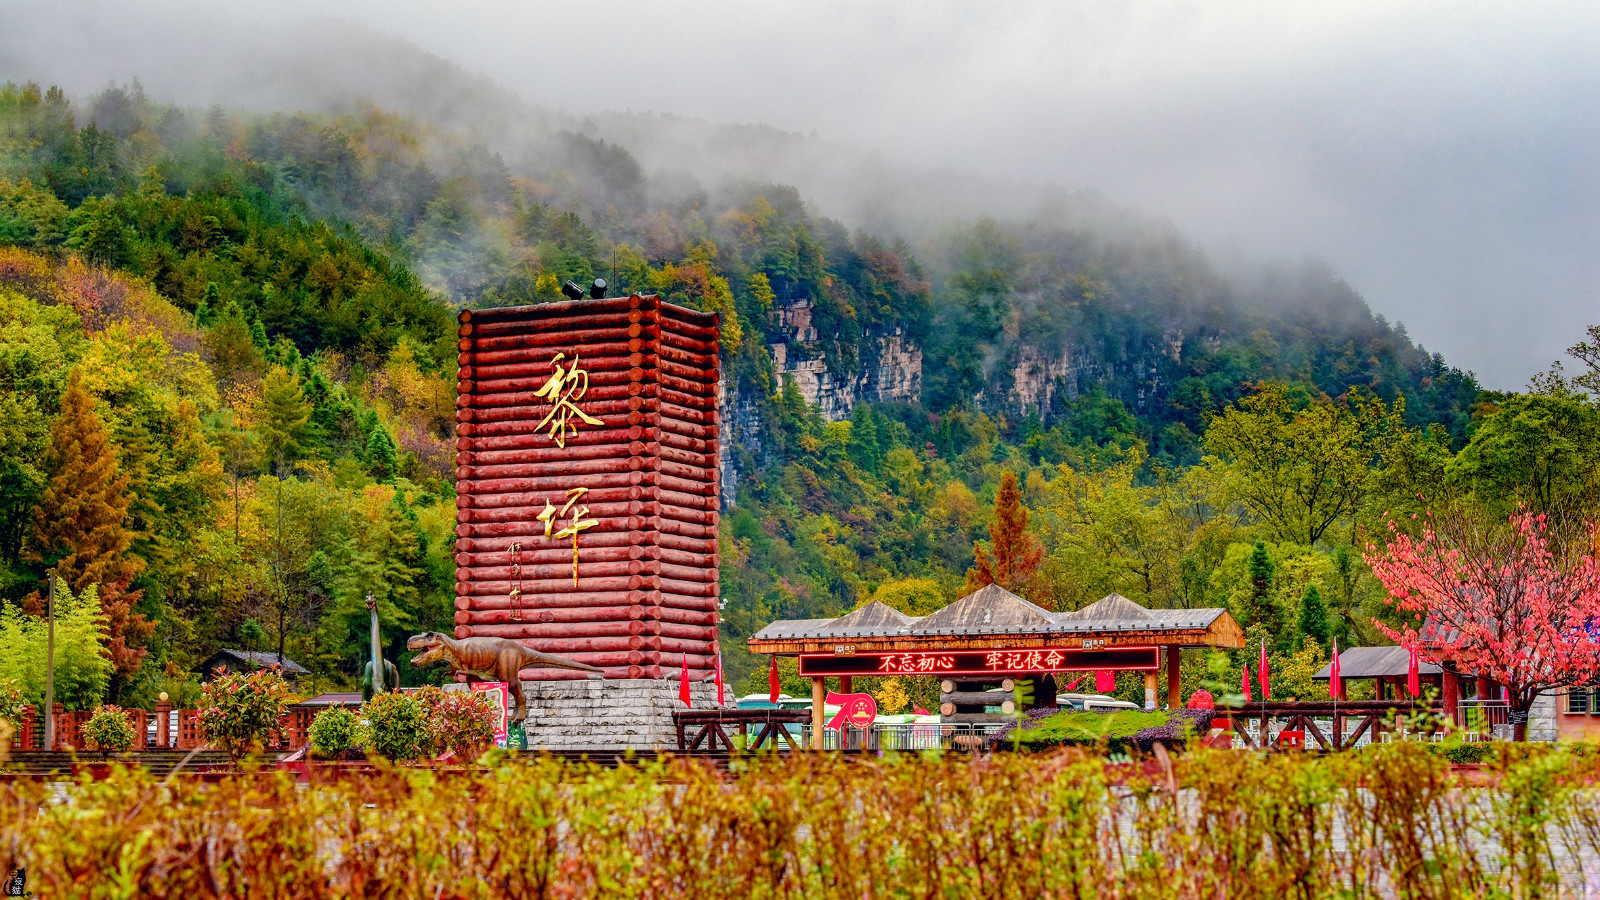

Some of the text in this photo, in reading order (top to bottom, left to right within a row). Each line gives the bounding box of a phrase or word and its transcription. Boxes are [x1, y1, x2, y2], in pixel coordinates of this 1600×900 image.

[533, 352, 604, 588] 黎坪
[879, 653, 954, 672] 不忘初心
[986, 650, 1064, 672] 牢记使命
[824, 690, 877, 732] 70
